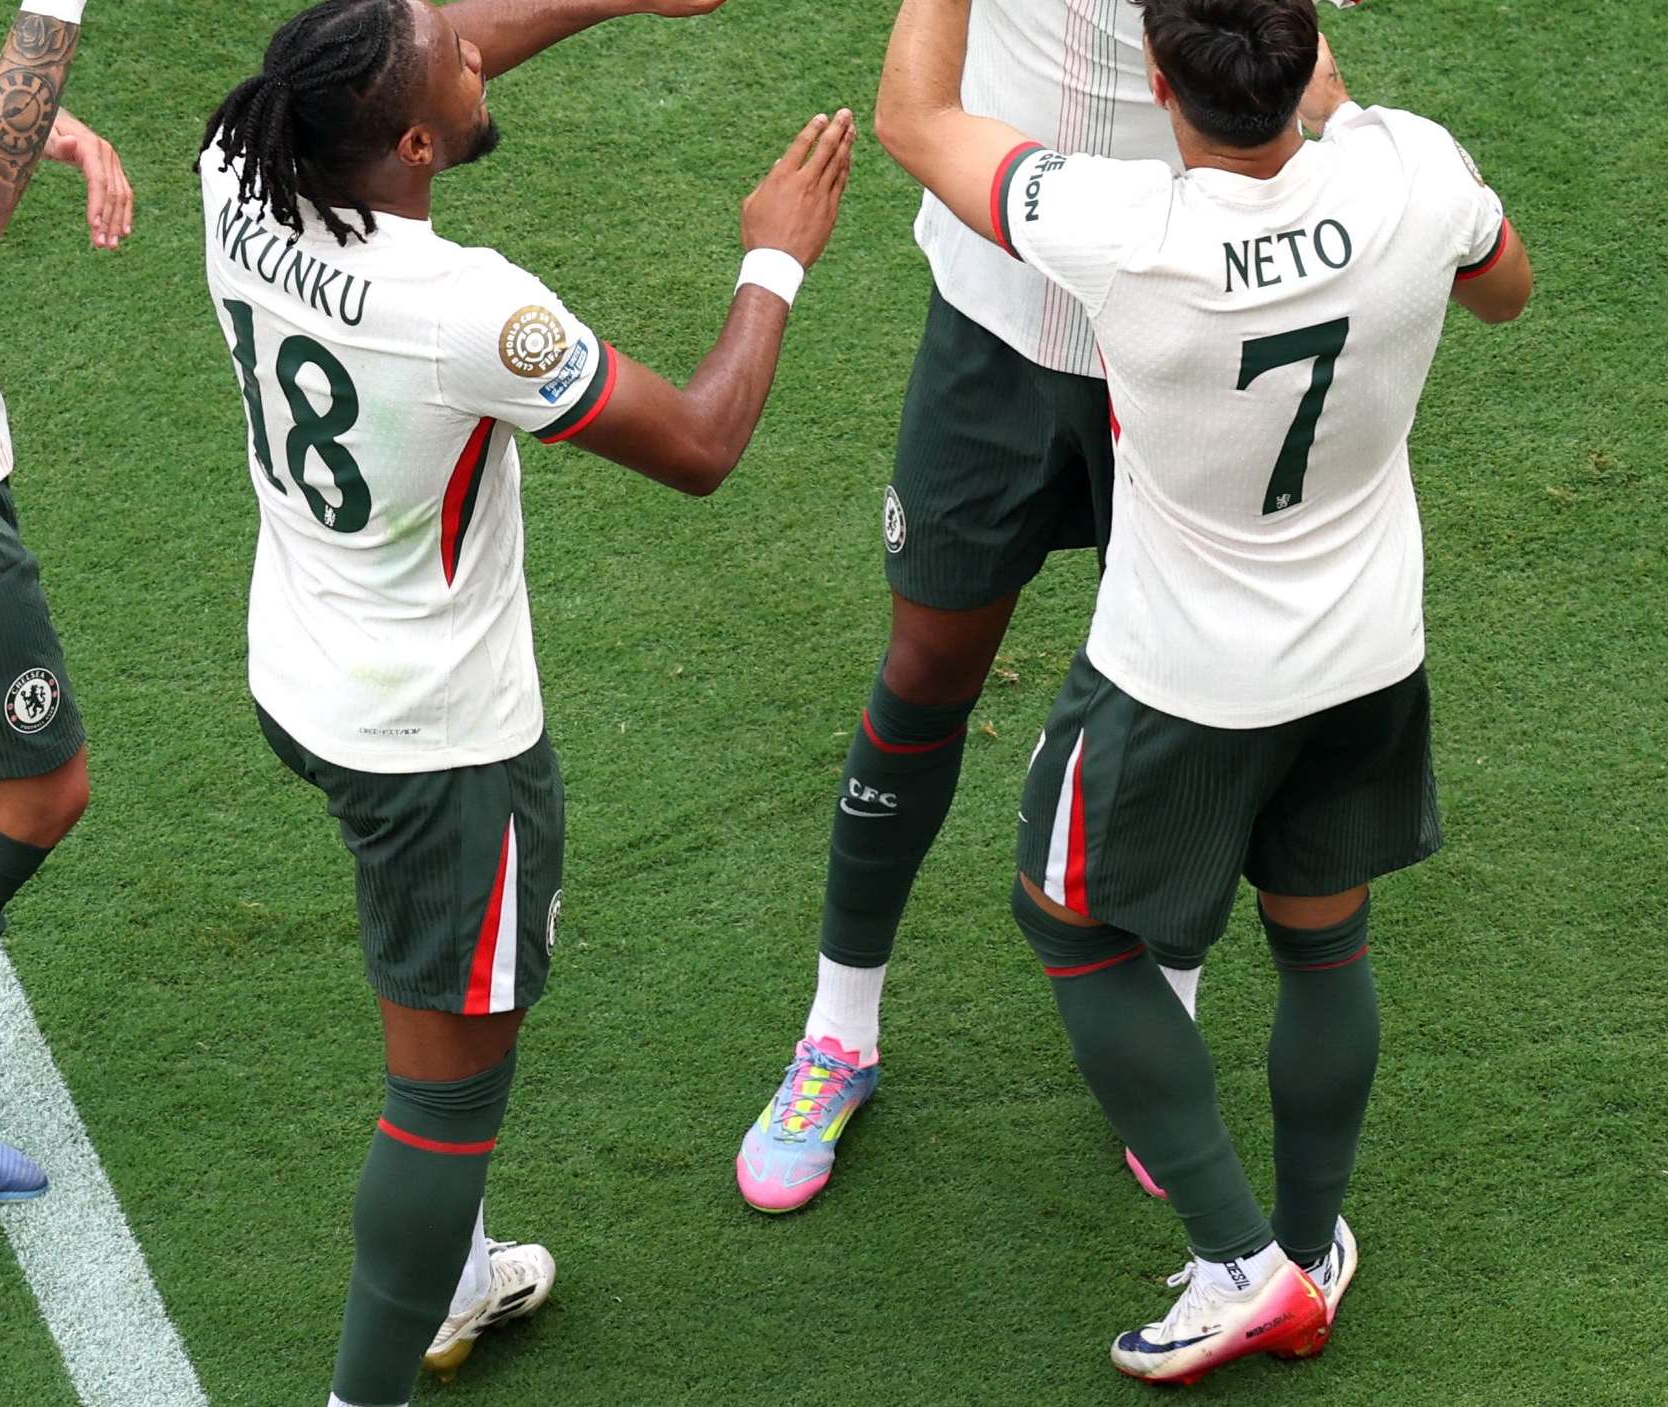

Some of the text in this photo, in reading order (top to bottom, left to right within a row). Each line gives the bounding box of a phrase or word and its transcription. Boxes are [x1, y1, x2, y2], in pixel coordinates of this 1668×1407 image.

[216, 197, 372, 326] NKUNKU
[1222, 218, 1352, 292] NETO
[505, 322, 521, 358] WORLD
[510, 356, 534, 371] CLUB
[538, 348, 563, 371] FIFA
[223, 298, 372, 533] 18
[1236, 316, 1350, 516] 7
[12, 671, 45, 695] CHELSEA
[849, 777, 898, 808] CFC
